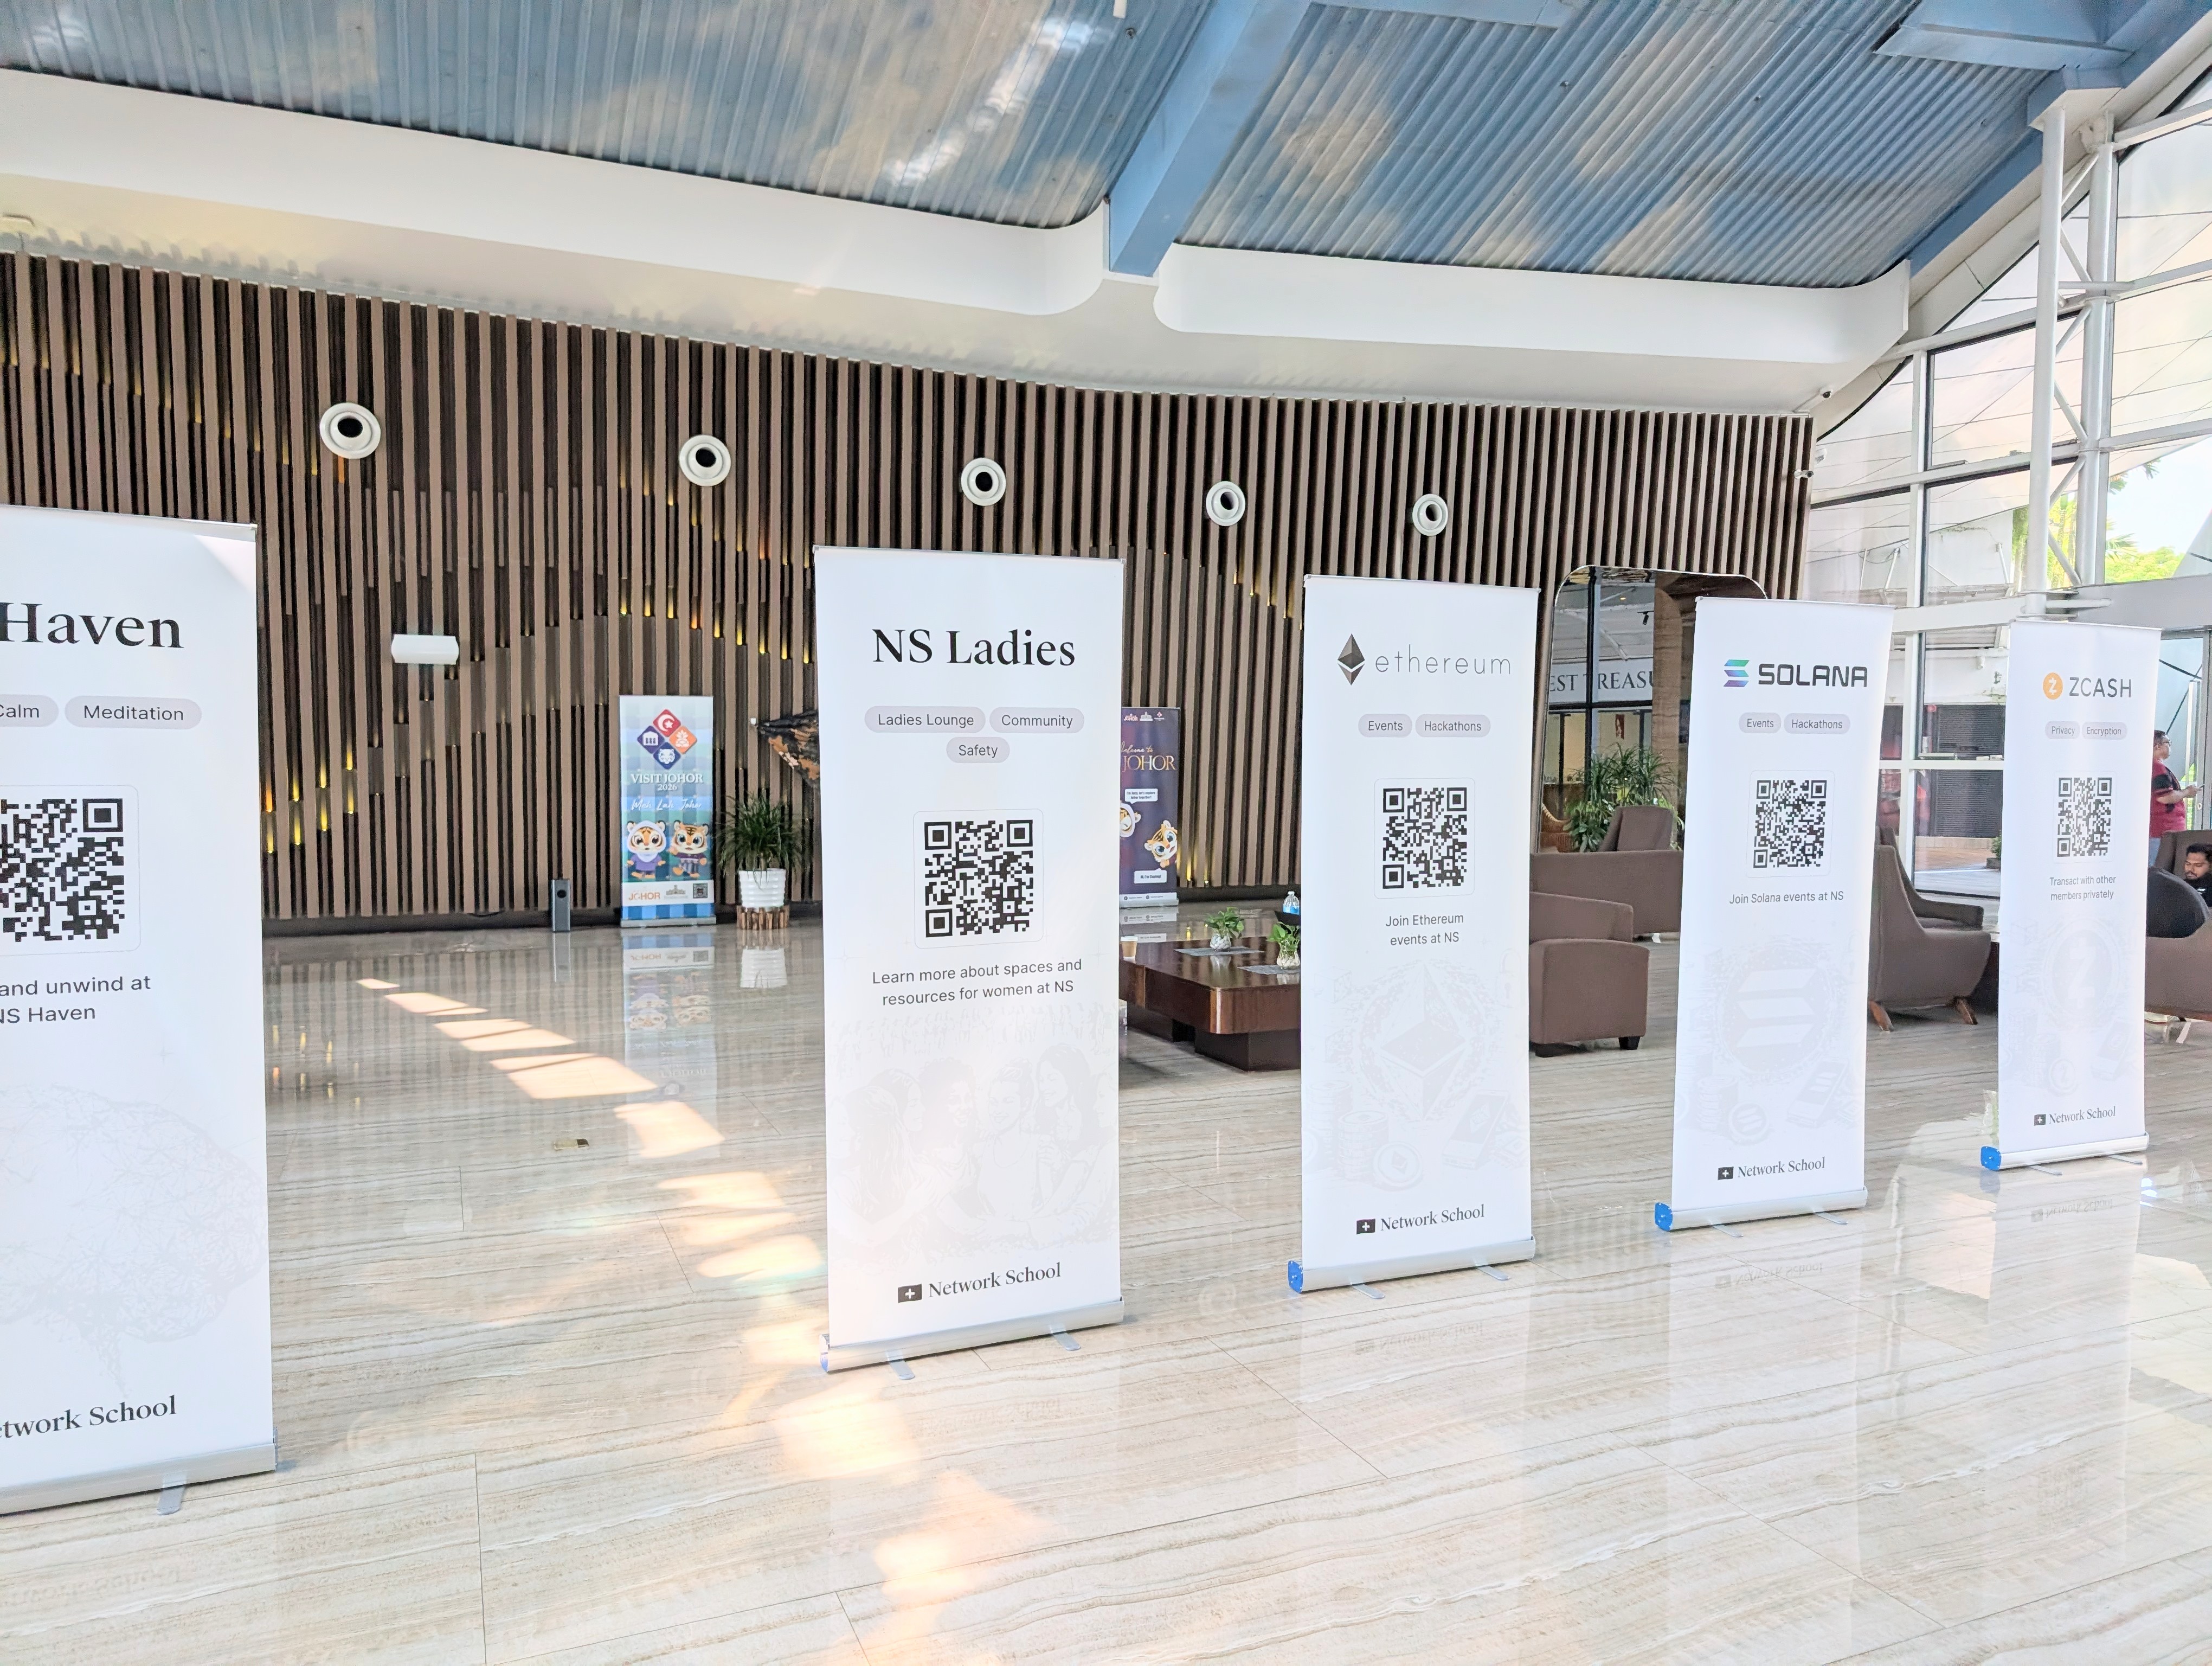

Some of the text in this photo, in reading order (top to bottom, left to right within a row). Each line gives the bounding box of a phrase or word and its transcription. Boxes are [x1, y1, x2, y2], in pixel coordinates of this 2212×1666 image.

[0, 602, 184, 649] Haven
[871, 628, 1076, 667] NS Ladies
[1375, 644, 1511, 675] ethereum
[1758, 663, 1868, 688] SOLANA
[2069, 677, 2132, 698] ZCASH
[84, 705, 184, 721] Meditation
[878, 714, 974, 729] Ladies Lounge
[1001, 714, 1073, 729] Community
[1368, 720, 1403, 731] Events
[1424, 721, 1482, 732] Hackathons
[1747, 718, 1774, 728] Events
[1791, 719, 1842, 729] Hackathons
[2052, 726, 2075, 736] Privacy
[2087, 727, 2121, 737] Encryption
[959, 744, 998, 759] Safety
[1122, 755, 1175, 772] JOHOR
[631, 773, 703, 784] VISIT JOHOR
[2049, 875, 2117, 886] Transact with other
[1729, 890, 1844, 904] Join Solana events at NS
[2050, 889, 2114, 901] members privately
[1385, 914, 1464, 927] Join Ethereum
[1390, 931, 1459, 946] events at NS
[873, 958, 1082, 984] Learn more about spaces and
[0, 976, 151, 997] and unwind at
[883, 980, 1074, 1006] resources for women at NS
[29, 1007, 96, 1022] Haven
[2049, 1105, 2116, 1124] Network School
[1737, 1156, 1825, 1178] Network School
[1381, 1203, 1485, 1231] Network School
[928, 1261, 1062, 1298] Network School
[89, 1394, 177, 1426] School
